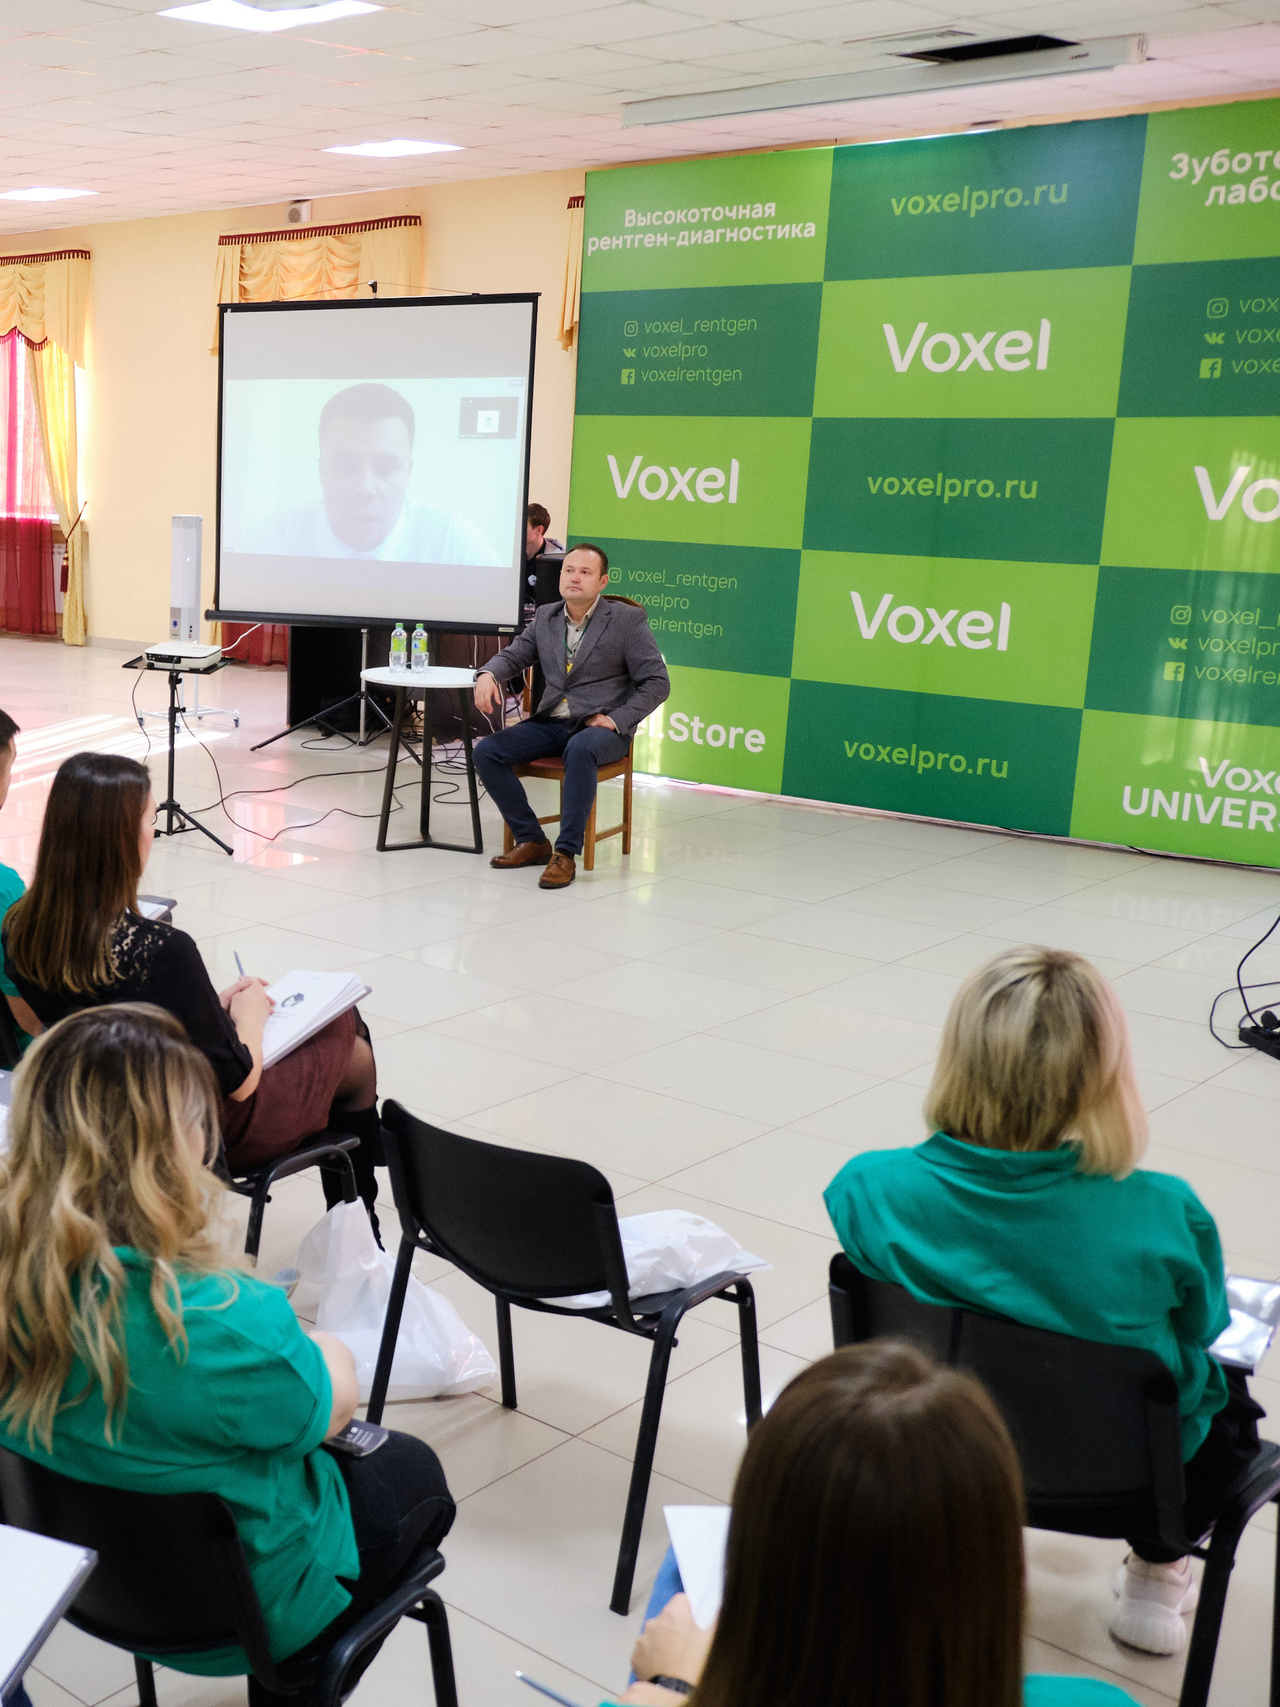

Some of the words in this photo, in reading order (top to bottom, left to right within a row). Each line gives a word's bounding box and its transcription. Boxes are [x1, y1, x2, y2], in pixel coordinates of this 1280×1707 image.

[624, 202, 776, 228] Высокоточная
[891, 183, 1068, 217] voxelpro.ru
[587, 222, 816, 256] рентген-диагностика
[644, 317, 757, 336] voxel_rentgen
[643, 342, 708, 361] voxelpro
[882, 318, 1051, 373] Voxel
[641, 366, 742, 386] voxelrentgen
[606, 455, 739, 504] Voxel
[867, 473, 1038, 503] voxelpro.ru
[627, 569, 738, 592] voxel_rentgen
[646, 616, 723, 639] elrentgen
[850, 591, 1011, 651] Voxel
[1201, 607, 1280, 629] voxel_
[1194, 665, 1280, 686] voxelre
[844, 741, 1008, 778] voxelpro.ru
[1198, 756, 1280, 795] Vox
[1122, 785, 1280, 833] UNIVER
